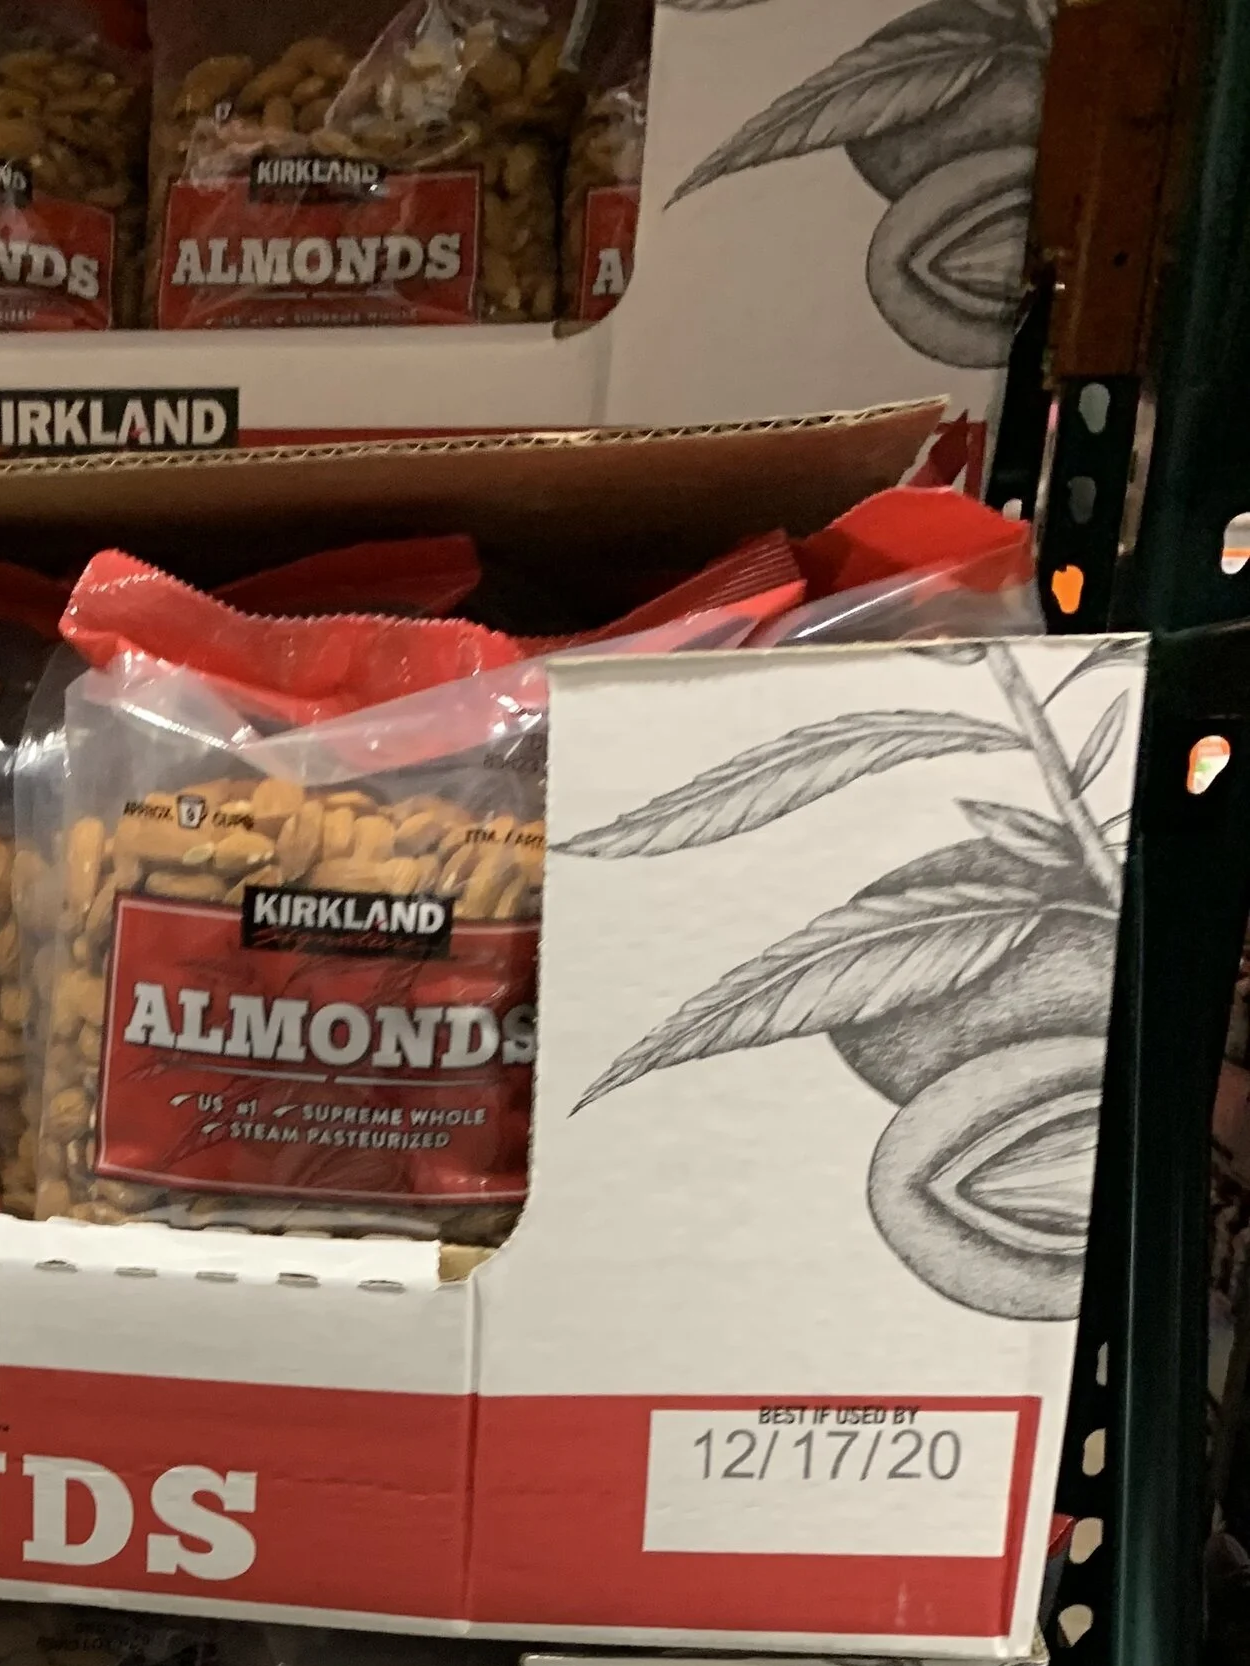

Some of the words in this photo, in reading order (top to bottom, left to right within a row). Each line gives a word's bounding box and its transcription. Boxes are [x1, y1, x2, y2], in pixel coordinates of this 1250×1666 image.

[257, 159, 378, 185] KIRKLAND
[171, 232, 461, 285] ALMONDS
[253, 892, 445, 935] KIRKLAND
[124, 981, 537, 1069] ALMONDS
[198, 1093, 224, 1113] US
[302, 1104, 402, 1126] SUPREME
[410, 1107, 487, 1127] WHOLE
[230, 1121, 299, 1143] STEAM
[306, 1130, 450, 1149] PASTEURIZED
[758, 1406, 808, 1425] BEST
[812, 1406, 830, 1425] IF
[836, 1406, 887, 1425] USED
[892, 1406, 921, 1425] BY
[693, 1428, 962, 1481] 12/17/20
